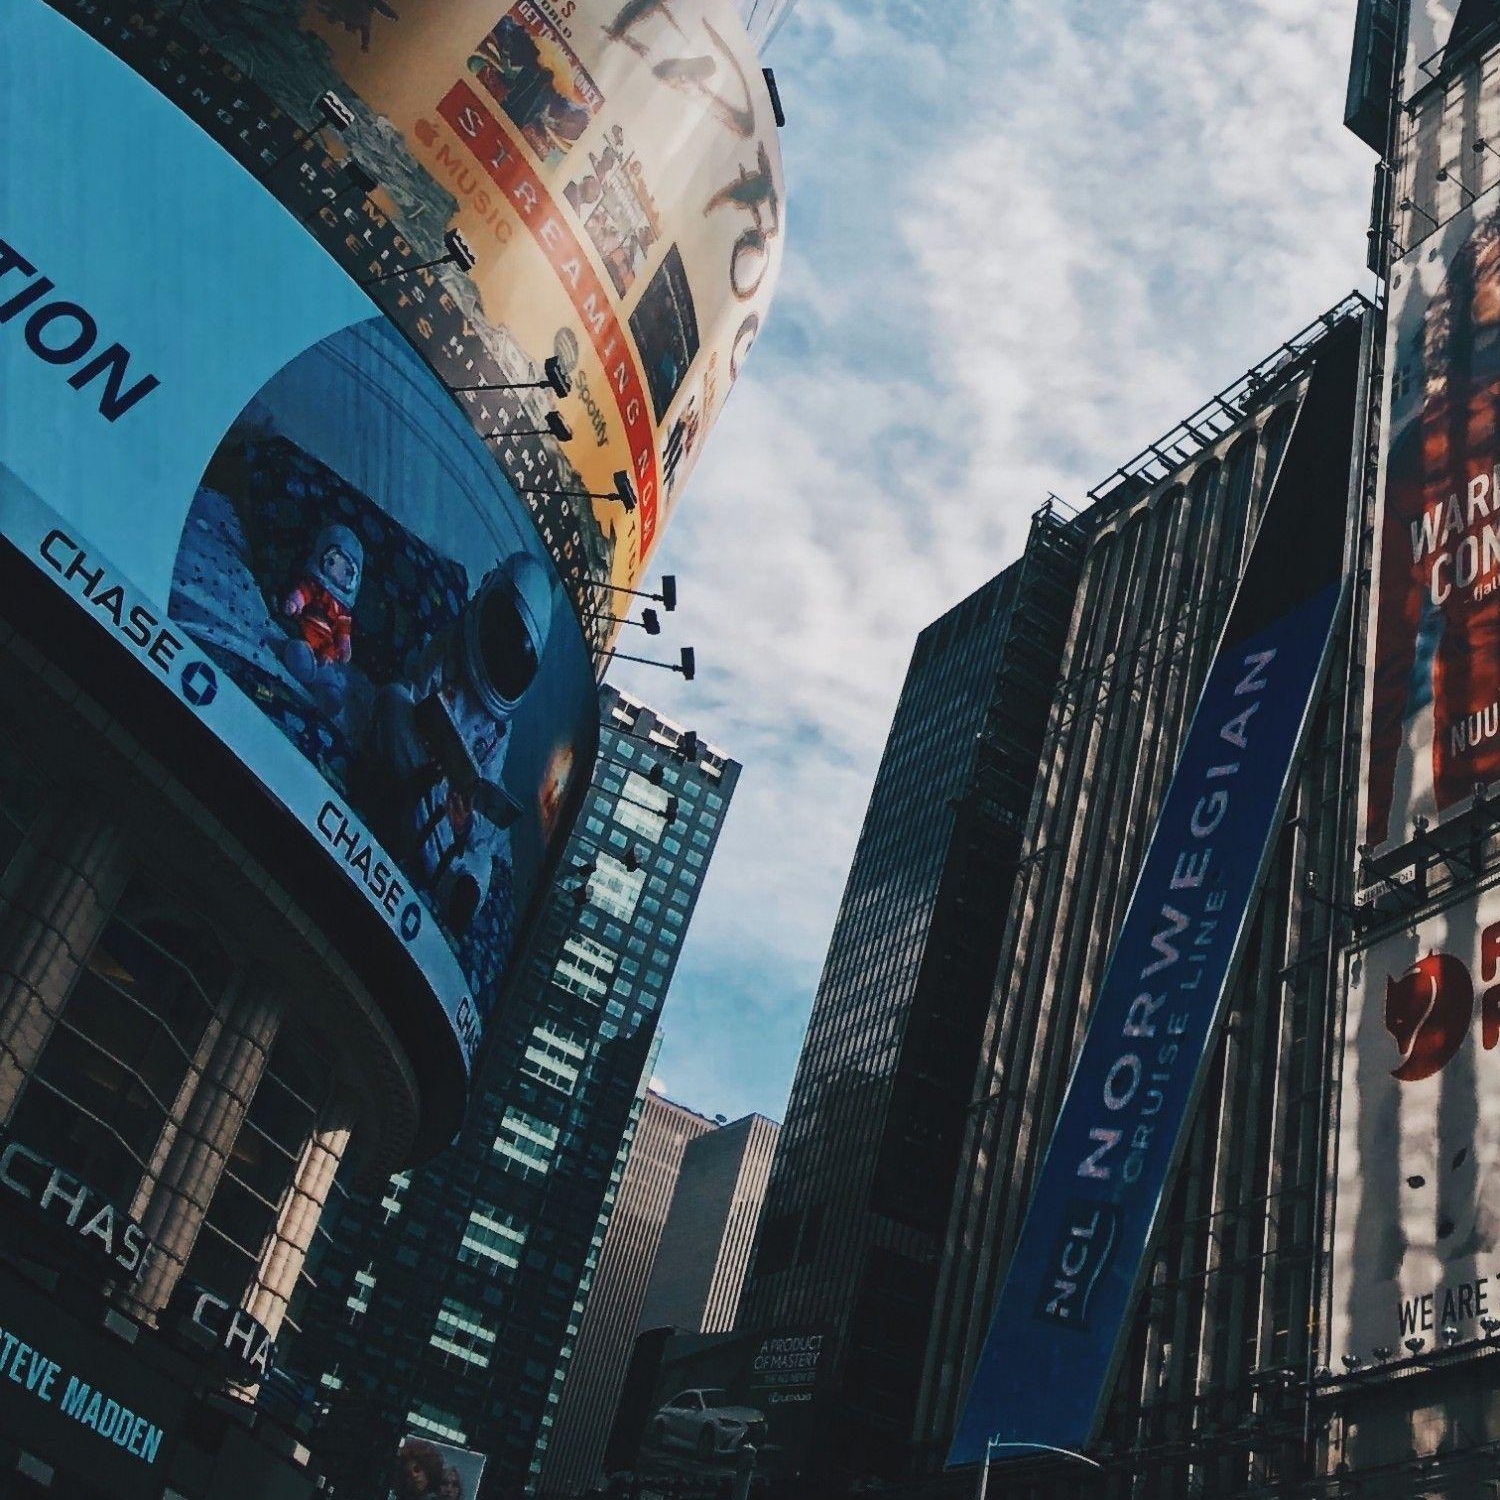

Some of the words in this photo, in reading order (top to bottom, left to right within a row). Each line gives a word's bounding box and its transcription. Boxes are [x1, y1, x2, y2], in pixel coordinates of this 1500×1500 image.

[518, 0, 541, 27] GET
[435, 143, 514, 245] MUSIC
[0, 237, 162, 423] TION
[446, 335, 489, 389] HIT
[457, 106, 641, 427] STREAMING
[637, 448, 655, 542] NOW
[574, 370, 610, 448] Spotify
[38, 528, 190, 676] CHASE
[316, 800, 407, 916] CHASE
[1044, 1209, 1100, 1320] NCL
[1076, 647, 1278, 1181] NORWEGIAN
[1121, 1010, 1190, 1186] CRUISE
[770, 1335, 823, 1351] PRODUCT
[771, 1352, 820, 1368] MASTERY
[1398, 1293, 1434, 1337] WE
[1439, 1277, 1489, 1327] ARE
[0, 1326, 62, 1402] TEVE
[59, 1375, 165, 1466] MADDEN
